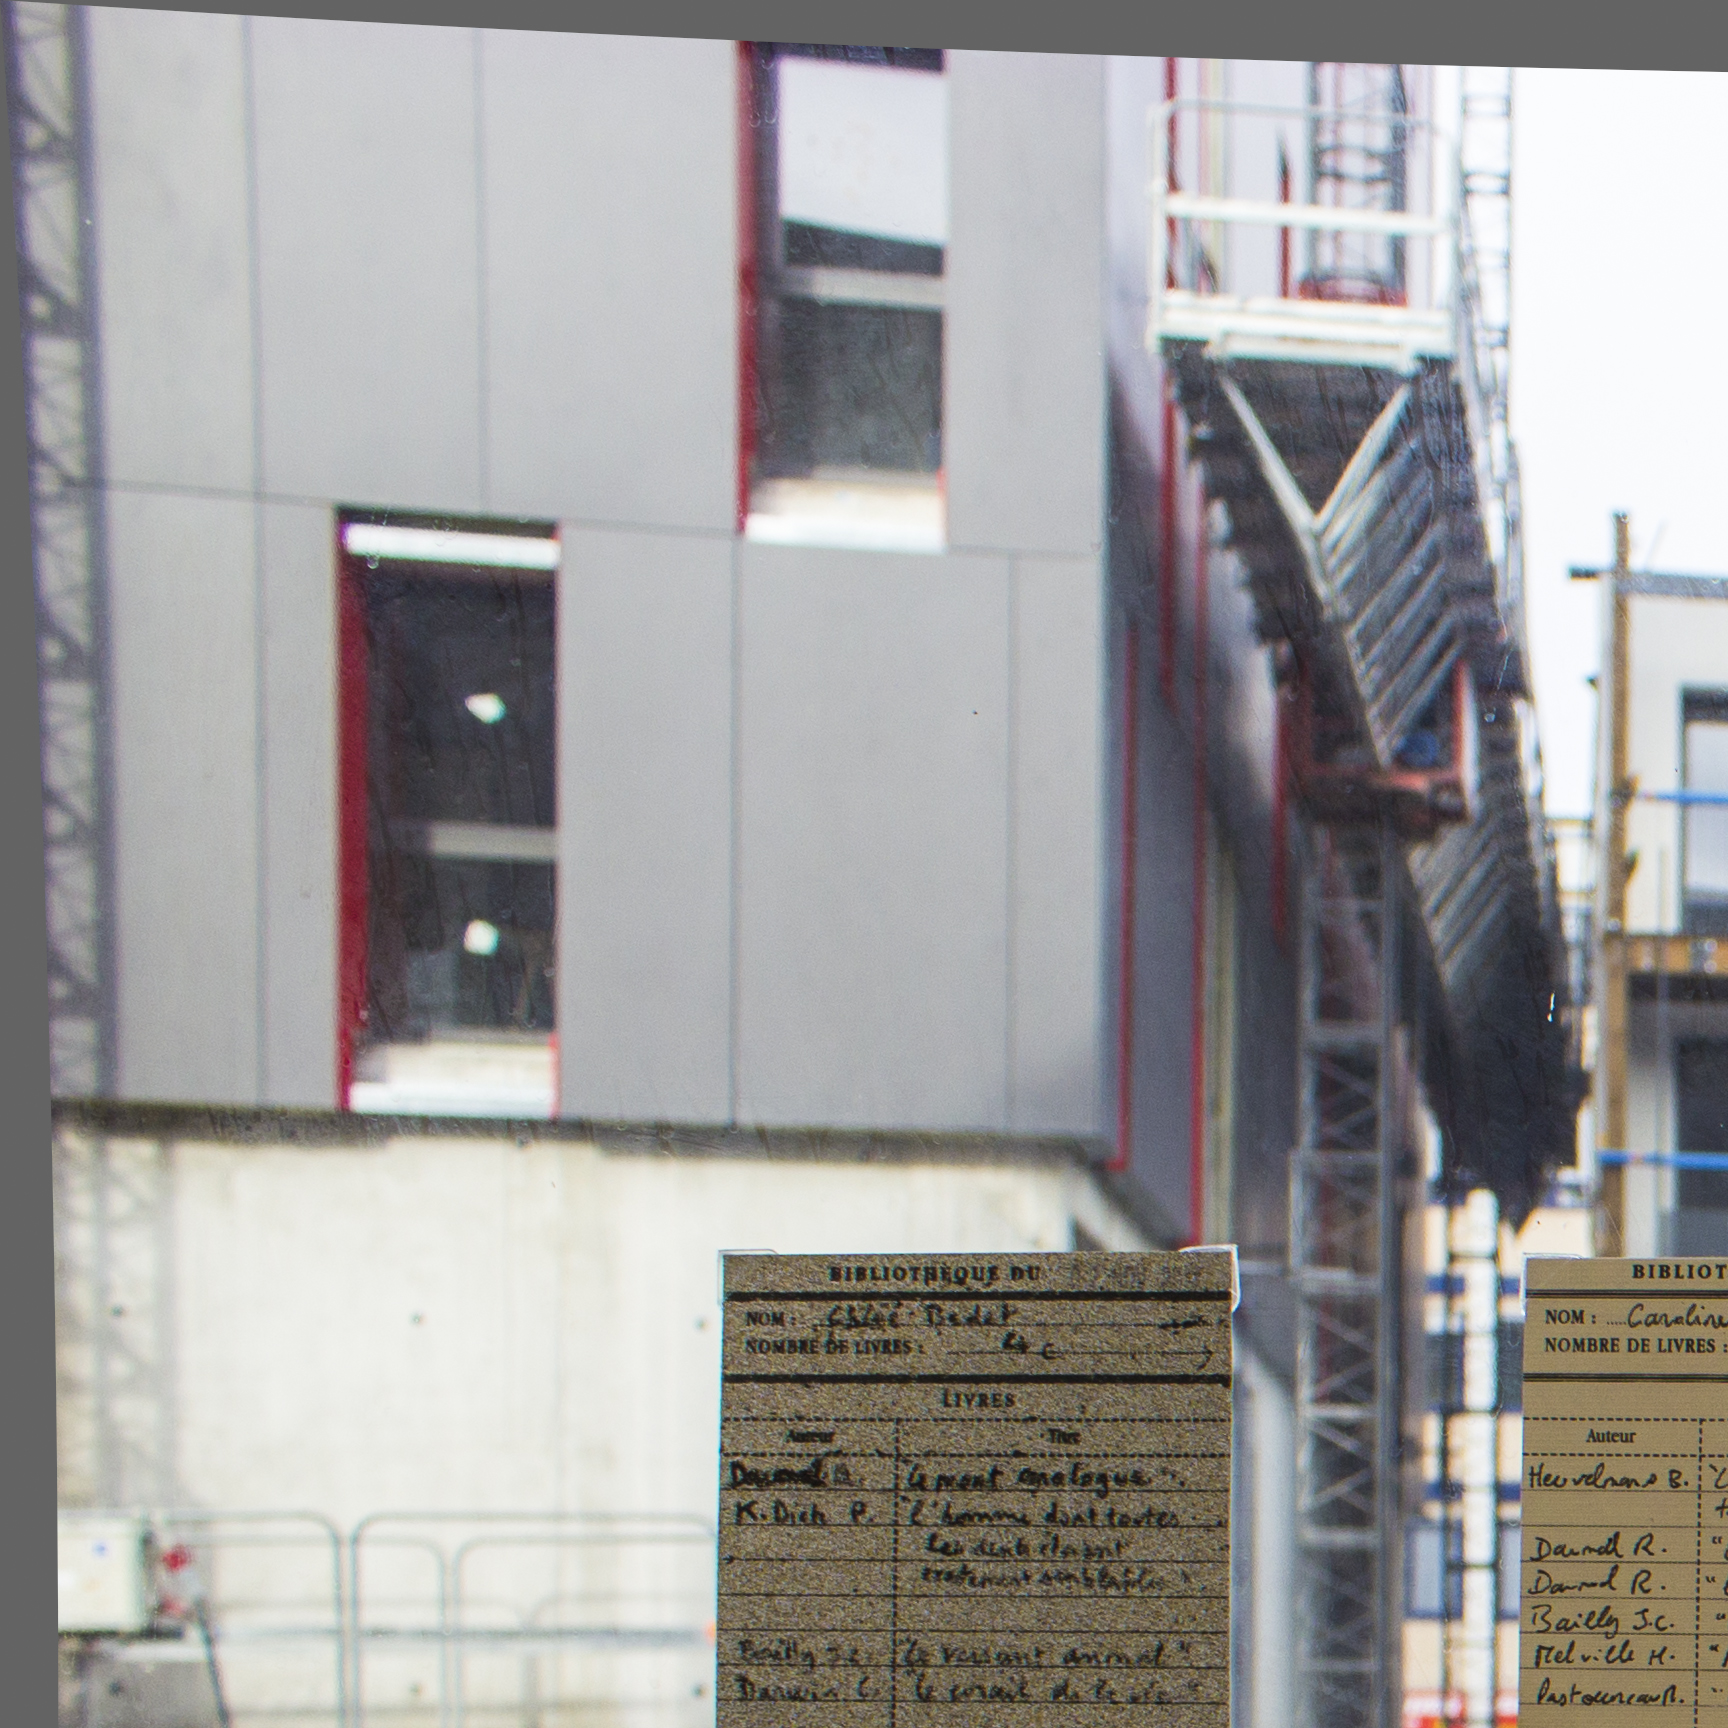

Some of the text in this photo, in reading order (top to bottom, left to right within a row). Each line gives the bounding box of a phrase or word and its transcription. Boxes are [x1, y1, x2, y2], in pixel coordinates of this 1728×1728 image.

[1011, 1266, 1040, 1280] DU
[746, 1339, 817, 1355] NOMBRE
[824, 1339, 850, 1355] DE
[1545, 1338, 1621, 1353] NOMBRE
[1627, 1338, 1650, 1353] DE
[1657, 1338, 1716, 1354] LIVRES
[942, 1393, 1016, 1408] LIVRES
[1586, 1429, 1636, 1444] Auteur
[1633, 1532, 1668, 1557] R.
[1630, 1569, 1666, 1595] R.
[1534, 1639, 1635, 1669] Melville
